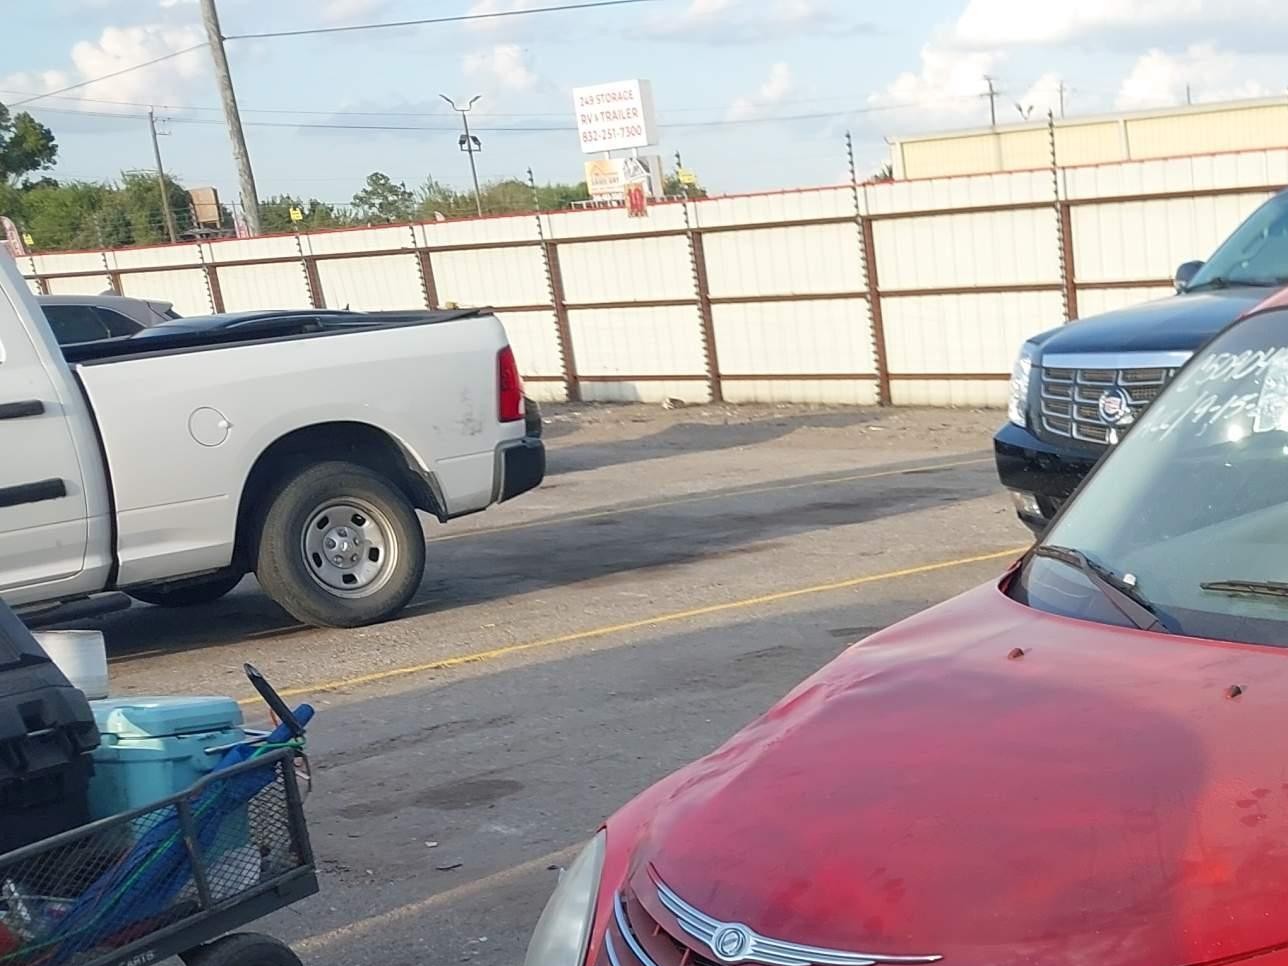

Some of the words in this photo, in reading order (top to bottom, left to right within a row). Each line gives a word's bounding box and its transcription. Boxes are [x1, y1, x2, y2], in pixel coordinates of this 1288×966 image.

[596, 89, 634, 105] STORAGE
[580, 113, 592, 126] RV
[600, 107, 639, 122] TRAILER
